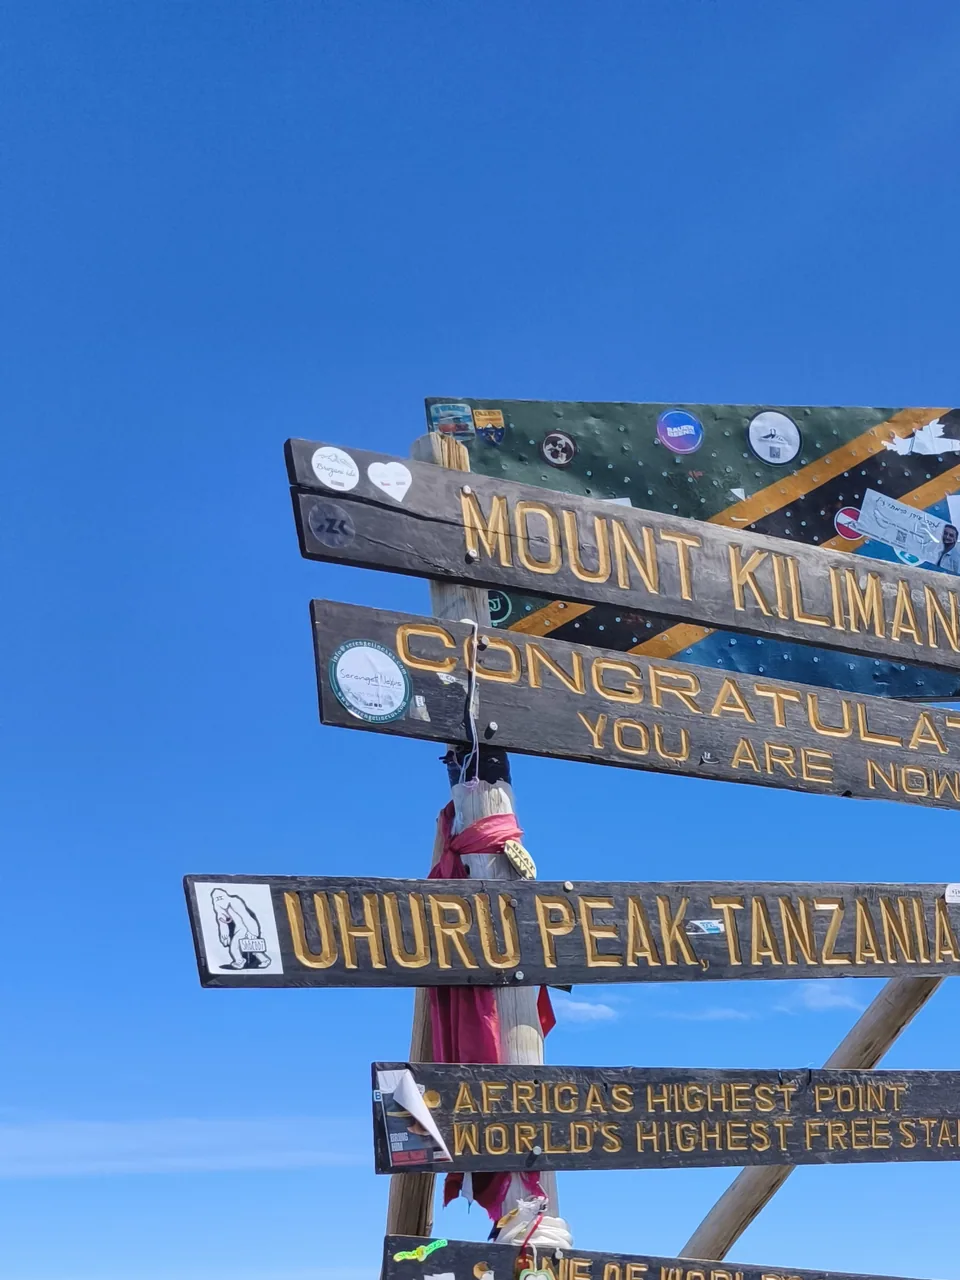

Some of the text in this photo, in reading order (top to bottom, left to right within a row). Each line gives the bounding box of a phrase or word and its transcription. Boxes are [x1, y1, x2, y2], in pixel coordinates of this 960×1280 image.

[460, 490, 701, 601] MOUNT
[577, 711, 691, 762] YOU
[731, 737, 834, 784] ARE
[283, 891, 520, 969] UHURU
[535, 894, 710, 972] PEAK,
[646, 1081, 796, 1113] HIGHEST
[813, 1083, 906, 1113] POINT
[452, 1119, 622, 1156] WORLD'S
[636, 1119, 796, 1153] HIGHEST
